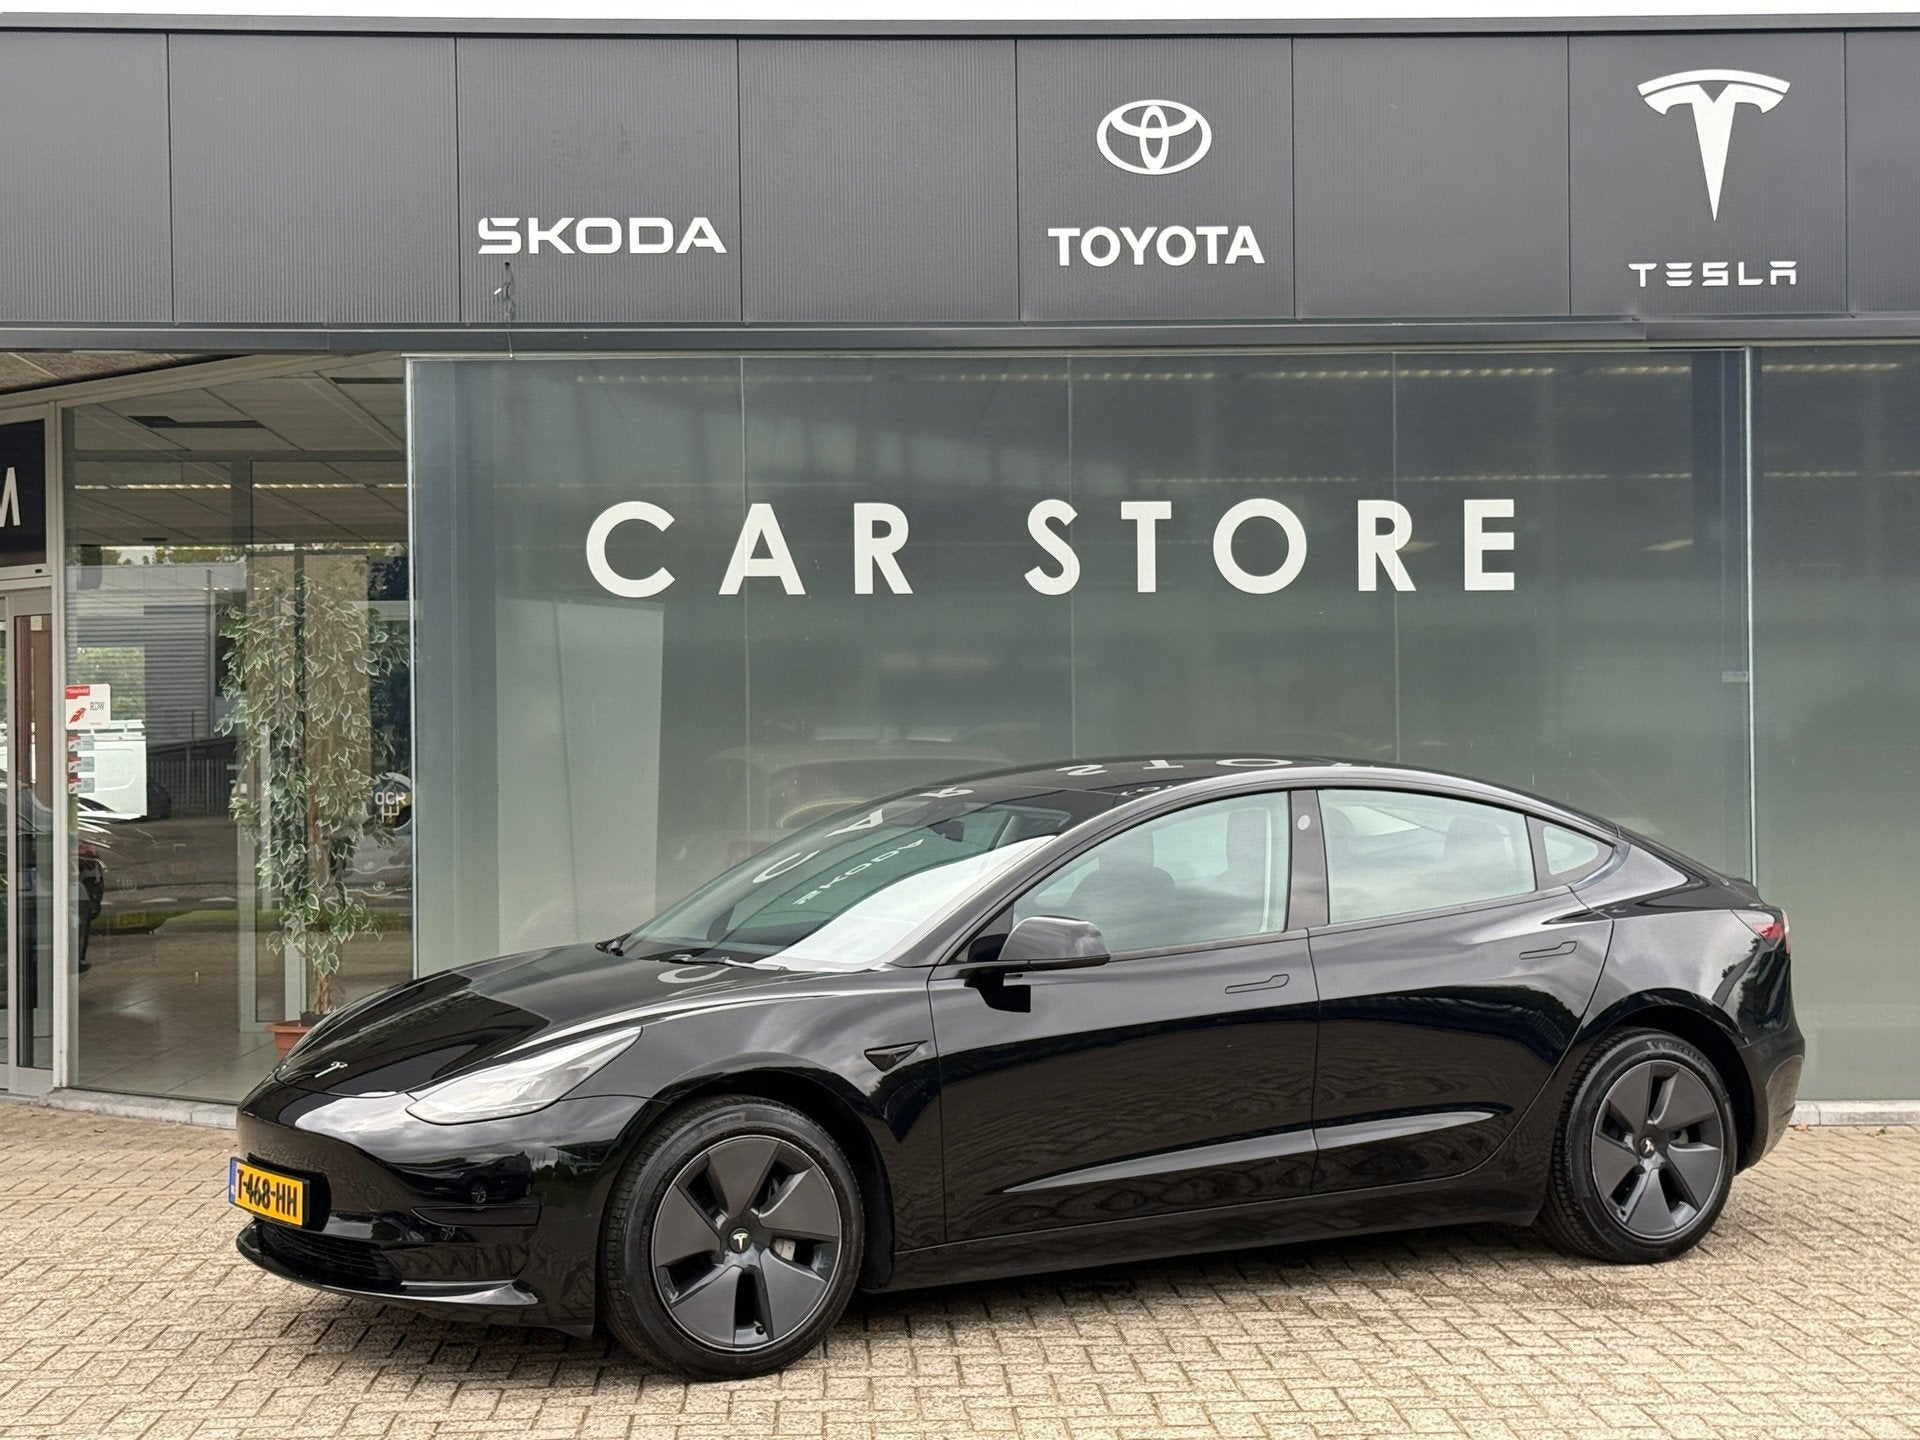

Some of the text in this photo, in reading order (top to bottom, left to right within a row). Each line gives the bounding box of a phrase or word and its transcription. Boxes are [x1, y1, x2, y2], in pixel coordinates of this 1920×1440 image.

[478, 217, 727, 254] SKODA
[1048, 224, 1266, 268] TOYOTA
[1628, 260, 1797, 288] TESLA
[586, 498, 1515, 598] CAR STORE
[237, 1168, 298, 1218] T-468-HH
